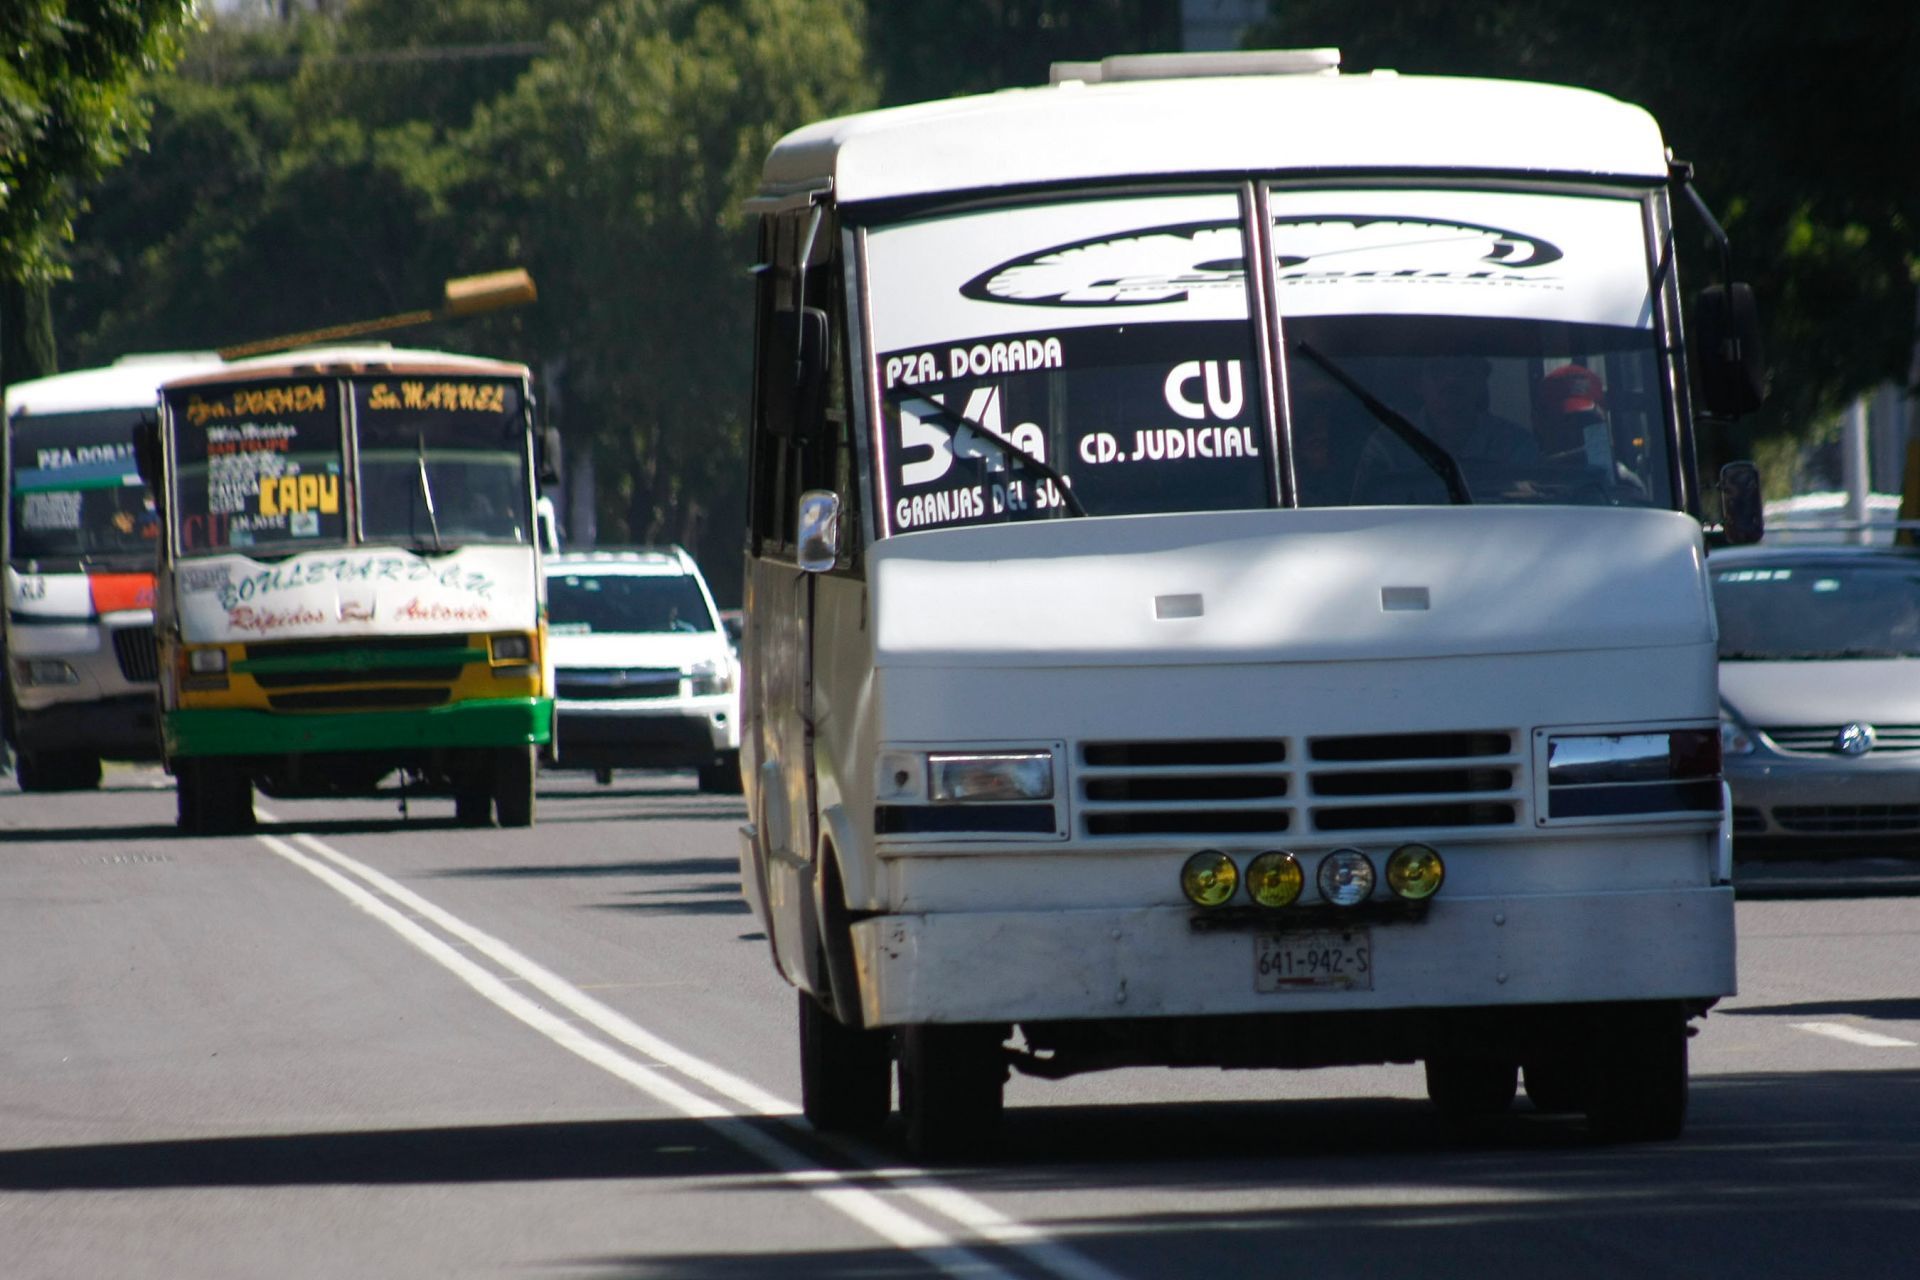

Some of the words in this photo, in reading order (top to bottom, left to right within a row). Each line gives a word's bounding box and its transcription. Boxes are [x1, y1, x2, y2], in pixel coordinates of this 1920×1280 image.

[887, 352, 944, 388] PZA.
[951, 337, 1062, 378] DORADA
[1164, 360, 1243, 420] CU
[1080, 433, 1126, 464] CD.
[1132, 426, 1259, 461] JUDICIAL
[260, 473, 339, 516] CAPU
[896, 486, 985, 528] GRANJAS
[992, 480, 1028, 514] DEL
[220, 557, 430, 612] BOULEVARD
[1259, 947, 1368, 976] 641-942-S
